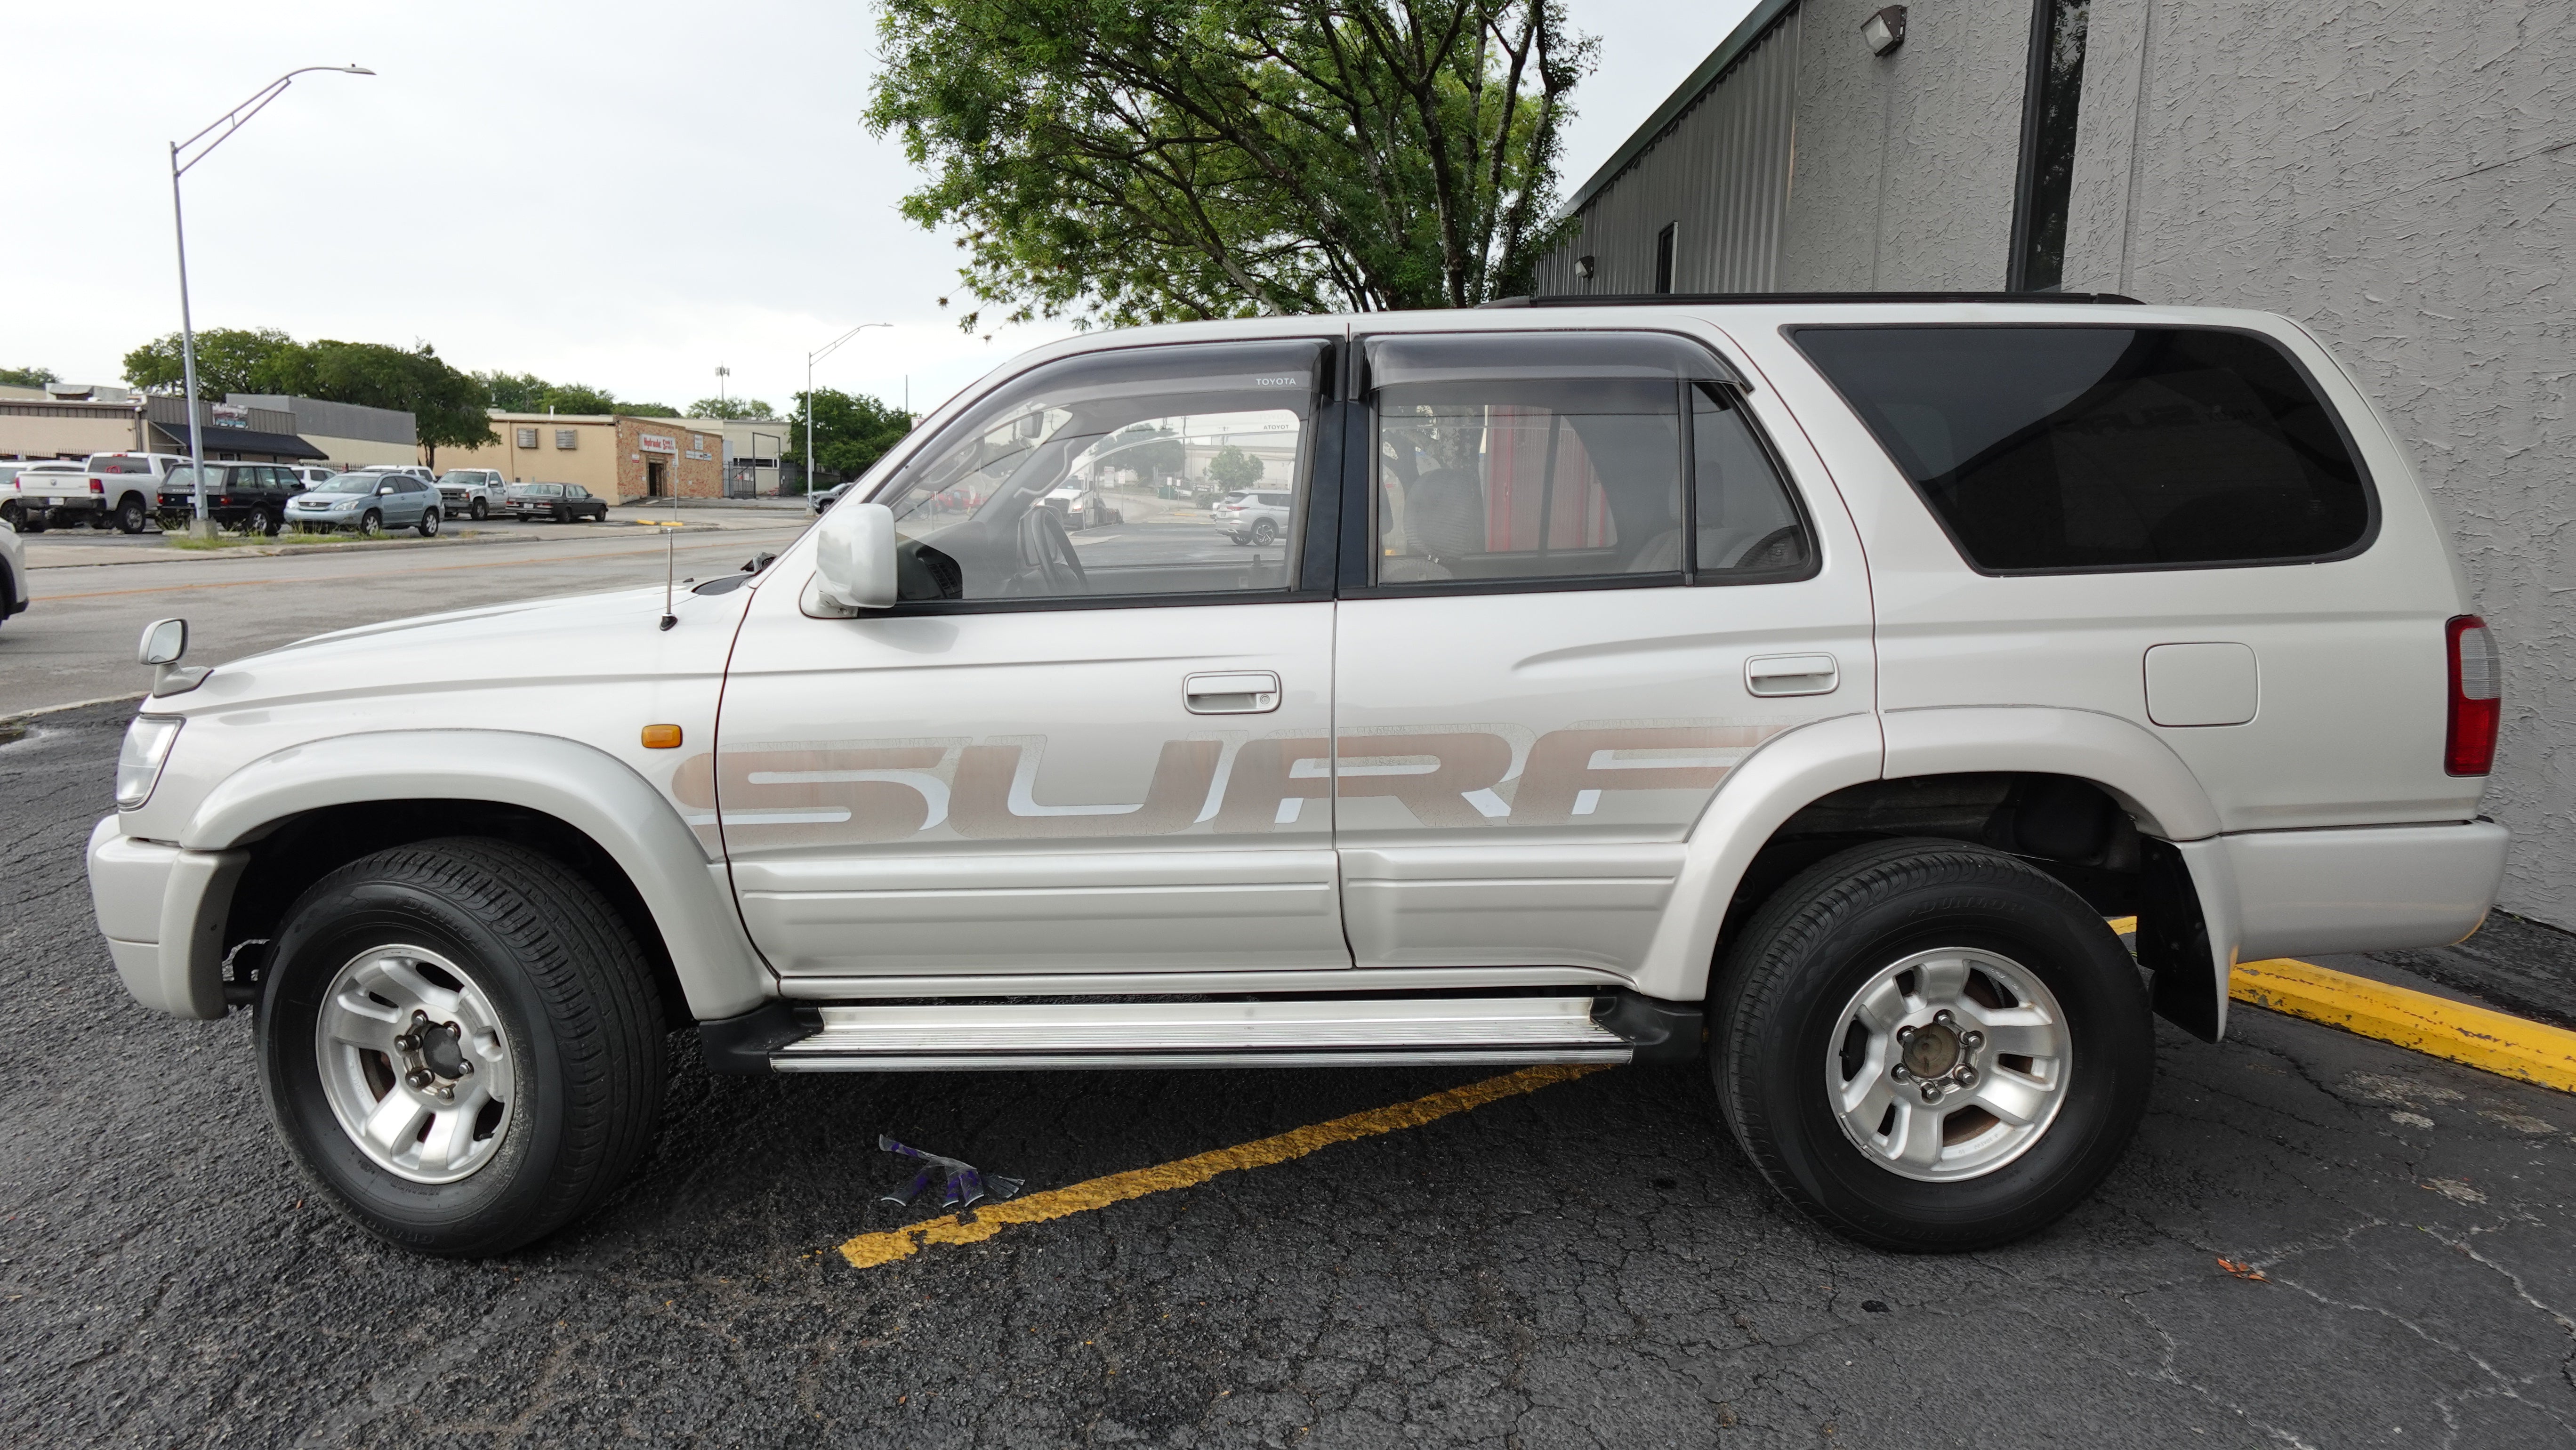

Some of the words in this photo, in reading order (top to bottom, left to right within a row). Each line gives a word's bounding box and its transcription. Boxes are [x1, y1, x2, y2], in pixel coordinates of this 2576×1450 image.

[672, 718, 1803, 846] SURF
[403, 896, 490, 952] DUNLOP
[1918, 895, 2026, 914] DUNLOP
